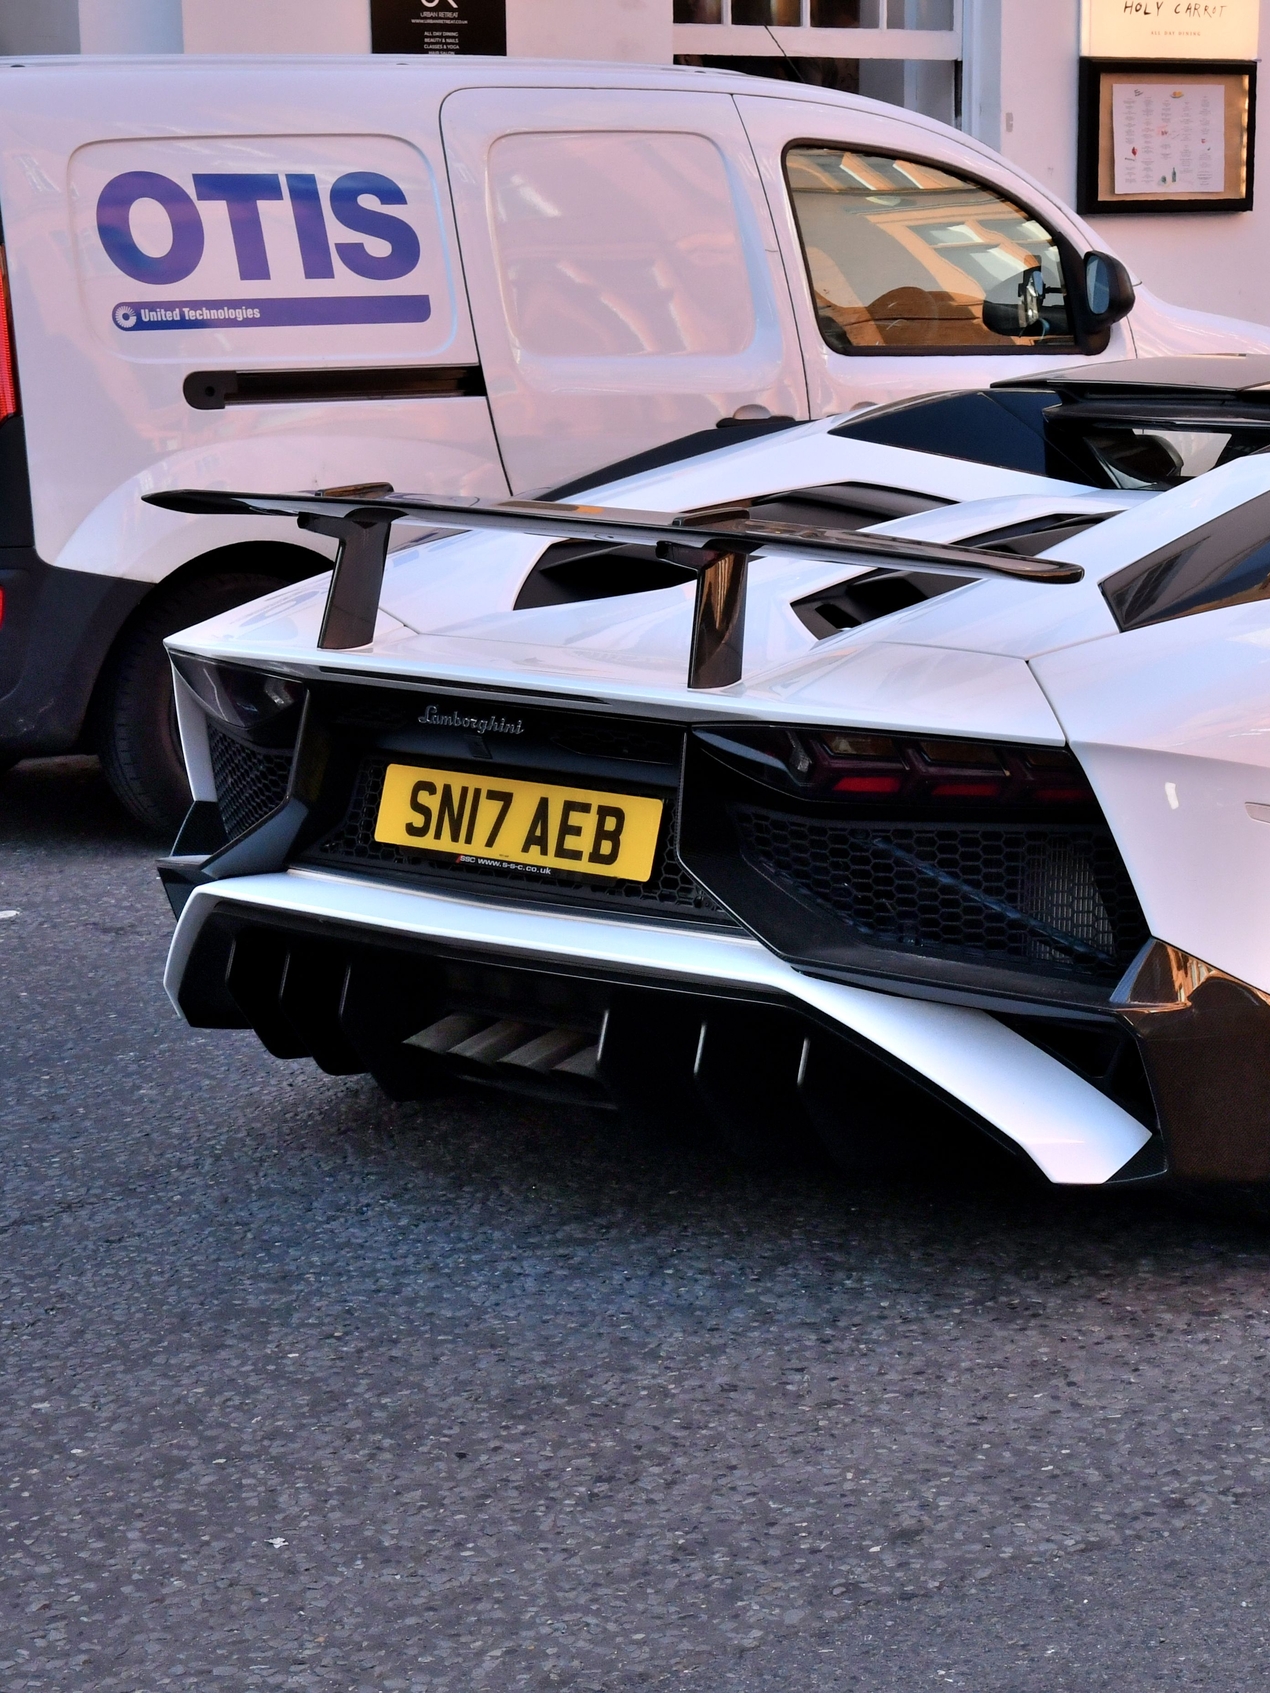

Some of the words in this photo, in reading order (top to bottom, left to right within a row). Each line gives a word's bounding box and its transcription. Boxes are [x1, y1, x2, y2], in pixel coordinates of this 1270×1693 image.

[1123, 1, 1163, 17] HOLY
[1173, 3, 1227, 18] CARROT
[96, 171, 421, 286] OTIS
[140, 308, 181, 322] United
[182, 306, 261, 321] Technologies
[417, 705, 524, 735] Lamborghini
[405, 779, 514, 848] SN17
[521, 796, 626, 866] AEB
[460, 855, 476, 863] SSC
[478, 857, 552, 875] www.s-s-c.co.uk
